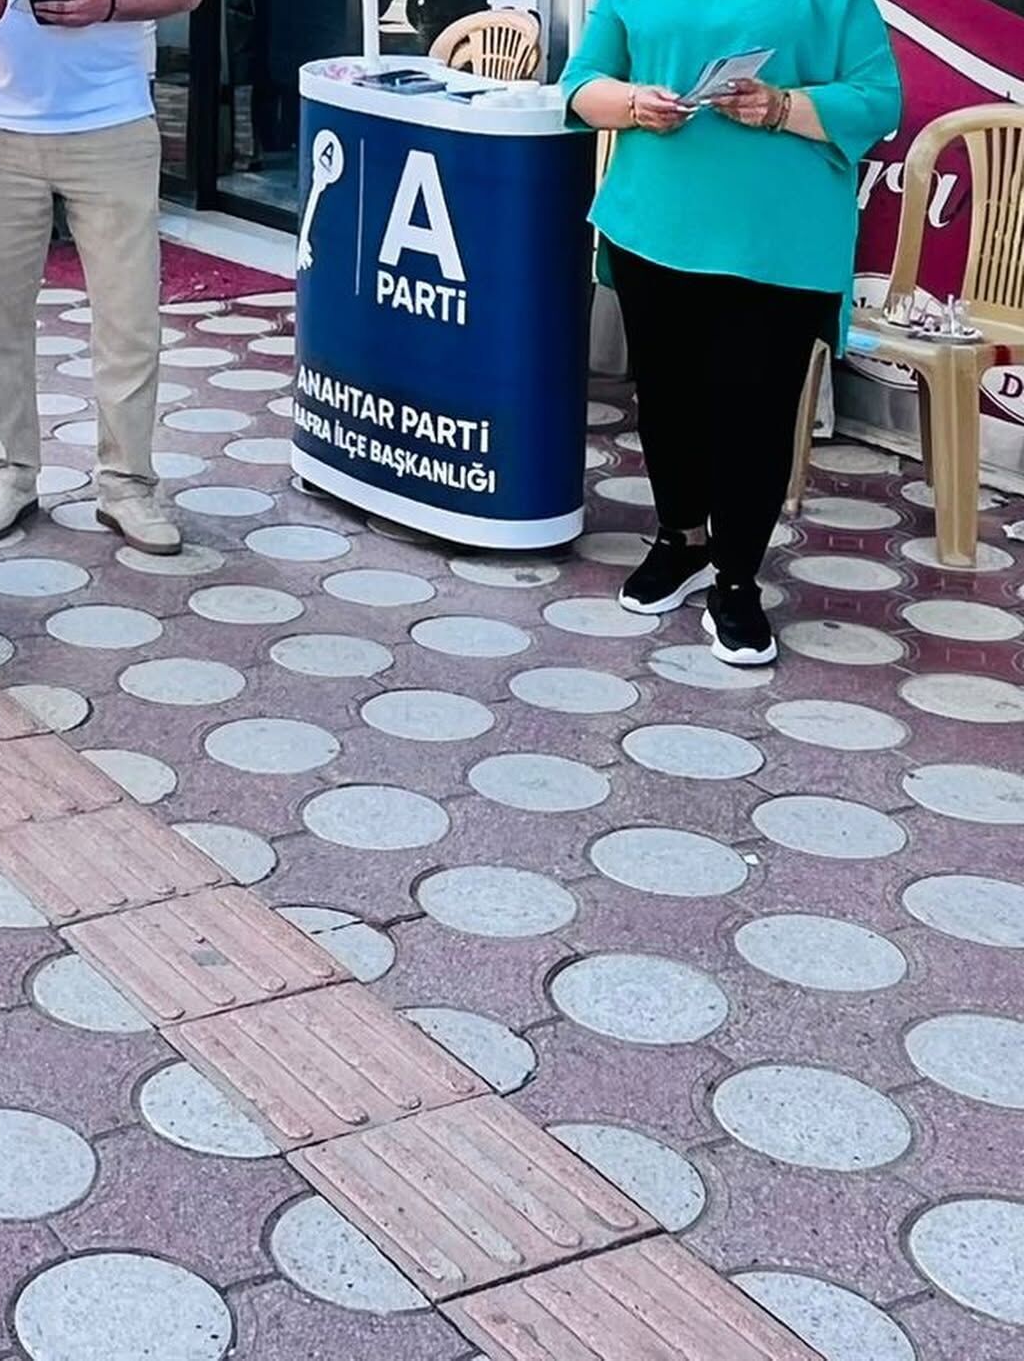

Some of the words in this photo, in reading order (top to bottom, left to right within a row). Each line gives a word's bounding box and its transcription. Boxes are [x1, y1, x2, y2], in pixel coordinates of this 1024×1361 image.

[378, 149, 466, 282] A
[376, 270, 467, 325] PARTİ
[297, 364, 395, 430] ANAHTAR
[401, 404, 490, 454] PARTİ
[334, 419, 367, 459] İLÇE
[369, 439, 496, 494] BAŞKANLIĞI
